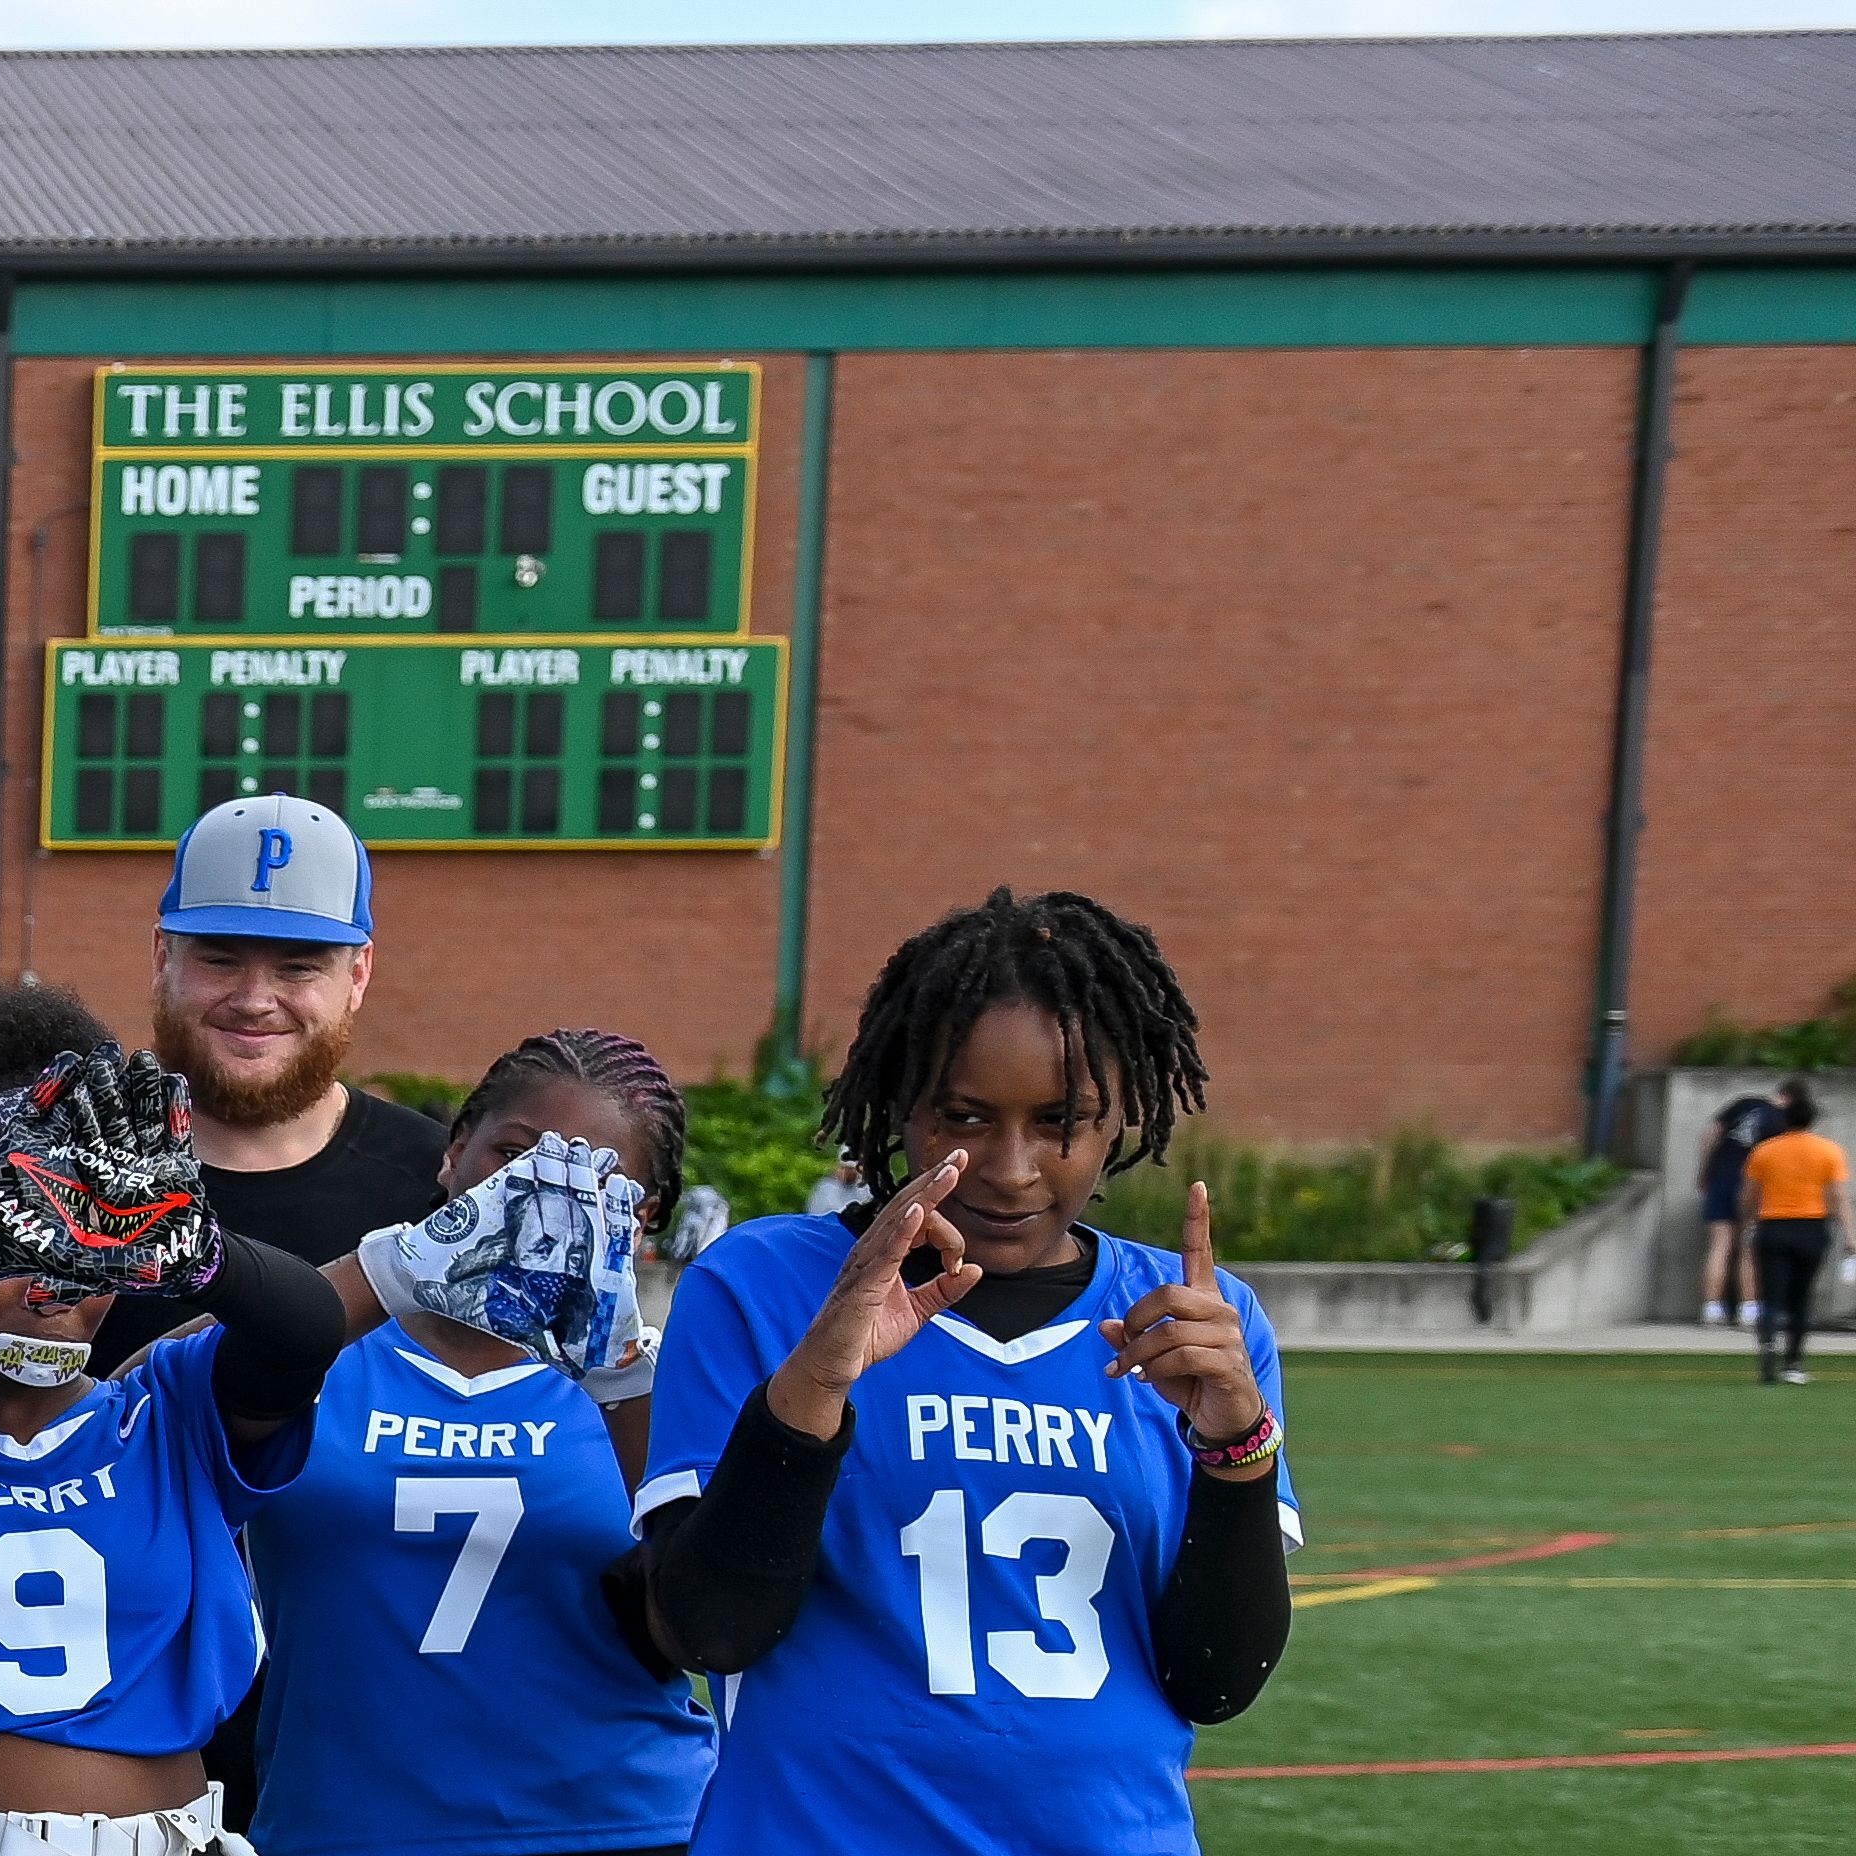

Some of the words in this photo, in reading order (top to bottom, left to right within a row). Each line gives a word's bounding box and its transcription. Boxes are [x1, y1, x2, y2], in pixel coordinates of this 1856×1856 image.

[118, 384, 248, 438] THE
[281, 382, 435, 437] ELLIS
[463, 380, 736, 436] SCHOOL
[121, 465, 261, 516] HOME
[582, 462, 731, 515] GUEST
[288, 575, 432, 619] PERIOD
[62, 650, 180, 686] PLAYER
[210, 649, 348, 686] PENALTY
[460, 649, 580, 685] PLAYER
[611, 648, 749, 685] PENALTY
[250, 828, 293, 892] P
[363, 1409, 557, 1458] PERRY
[906, 1394, 1113, 1474] PERRY
[394, 1477, 525, 1654] 7
[900, 1489, 1116, 1700] 13
